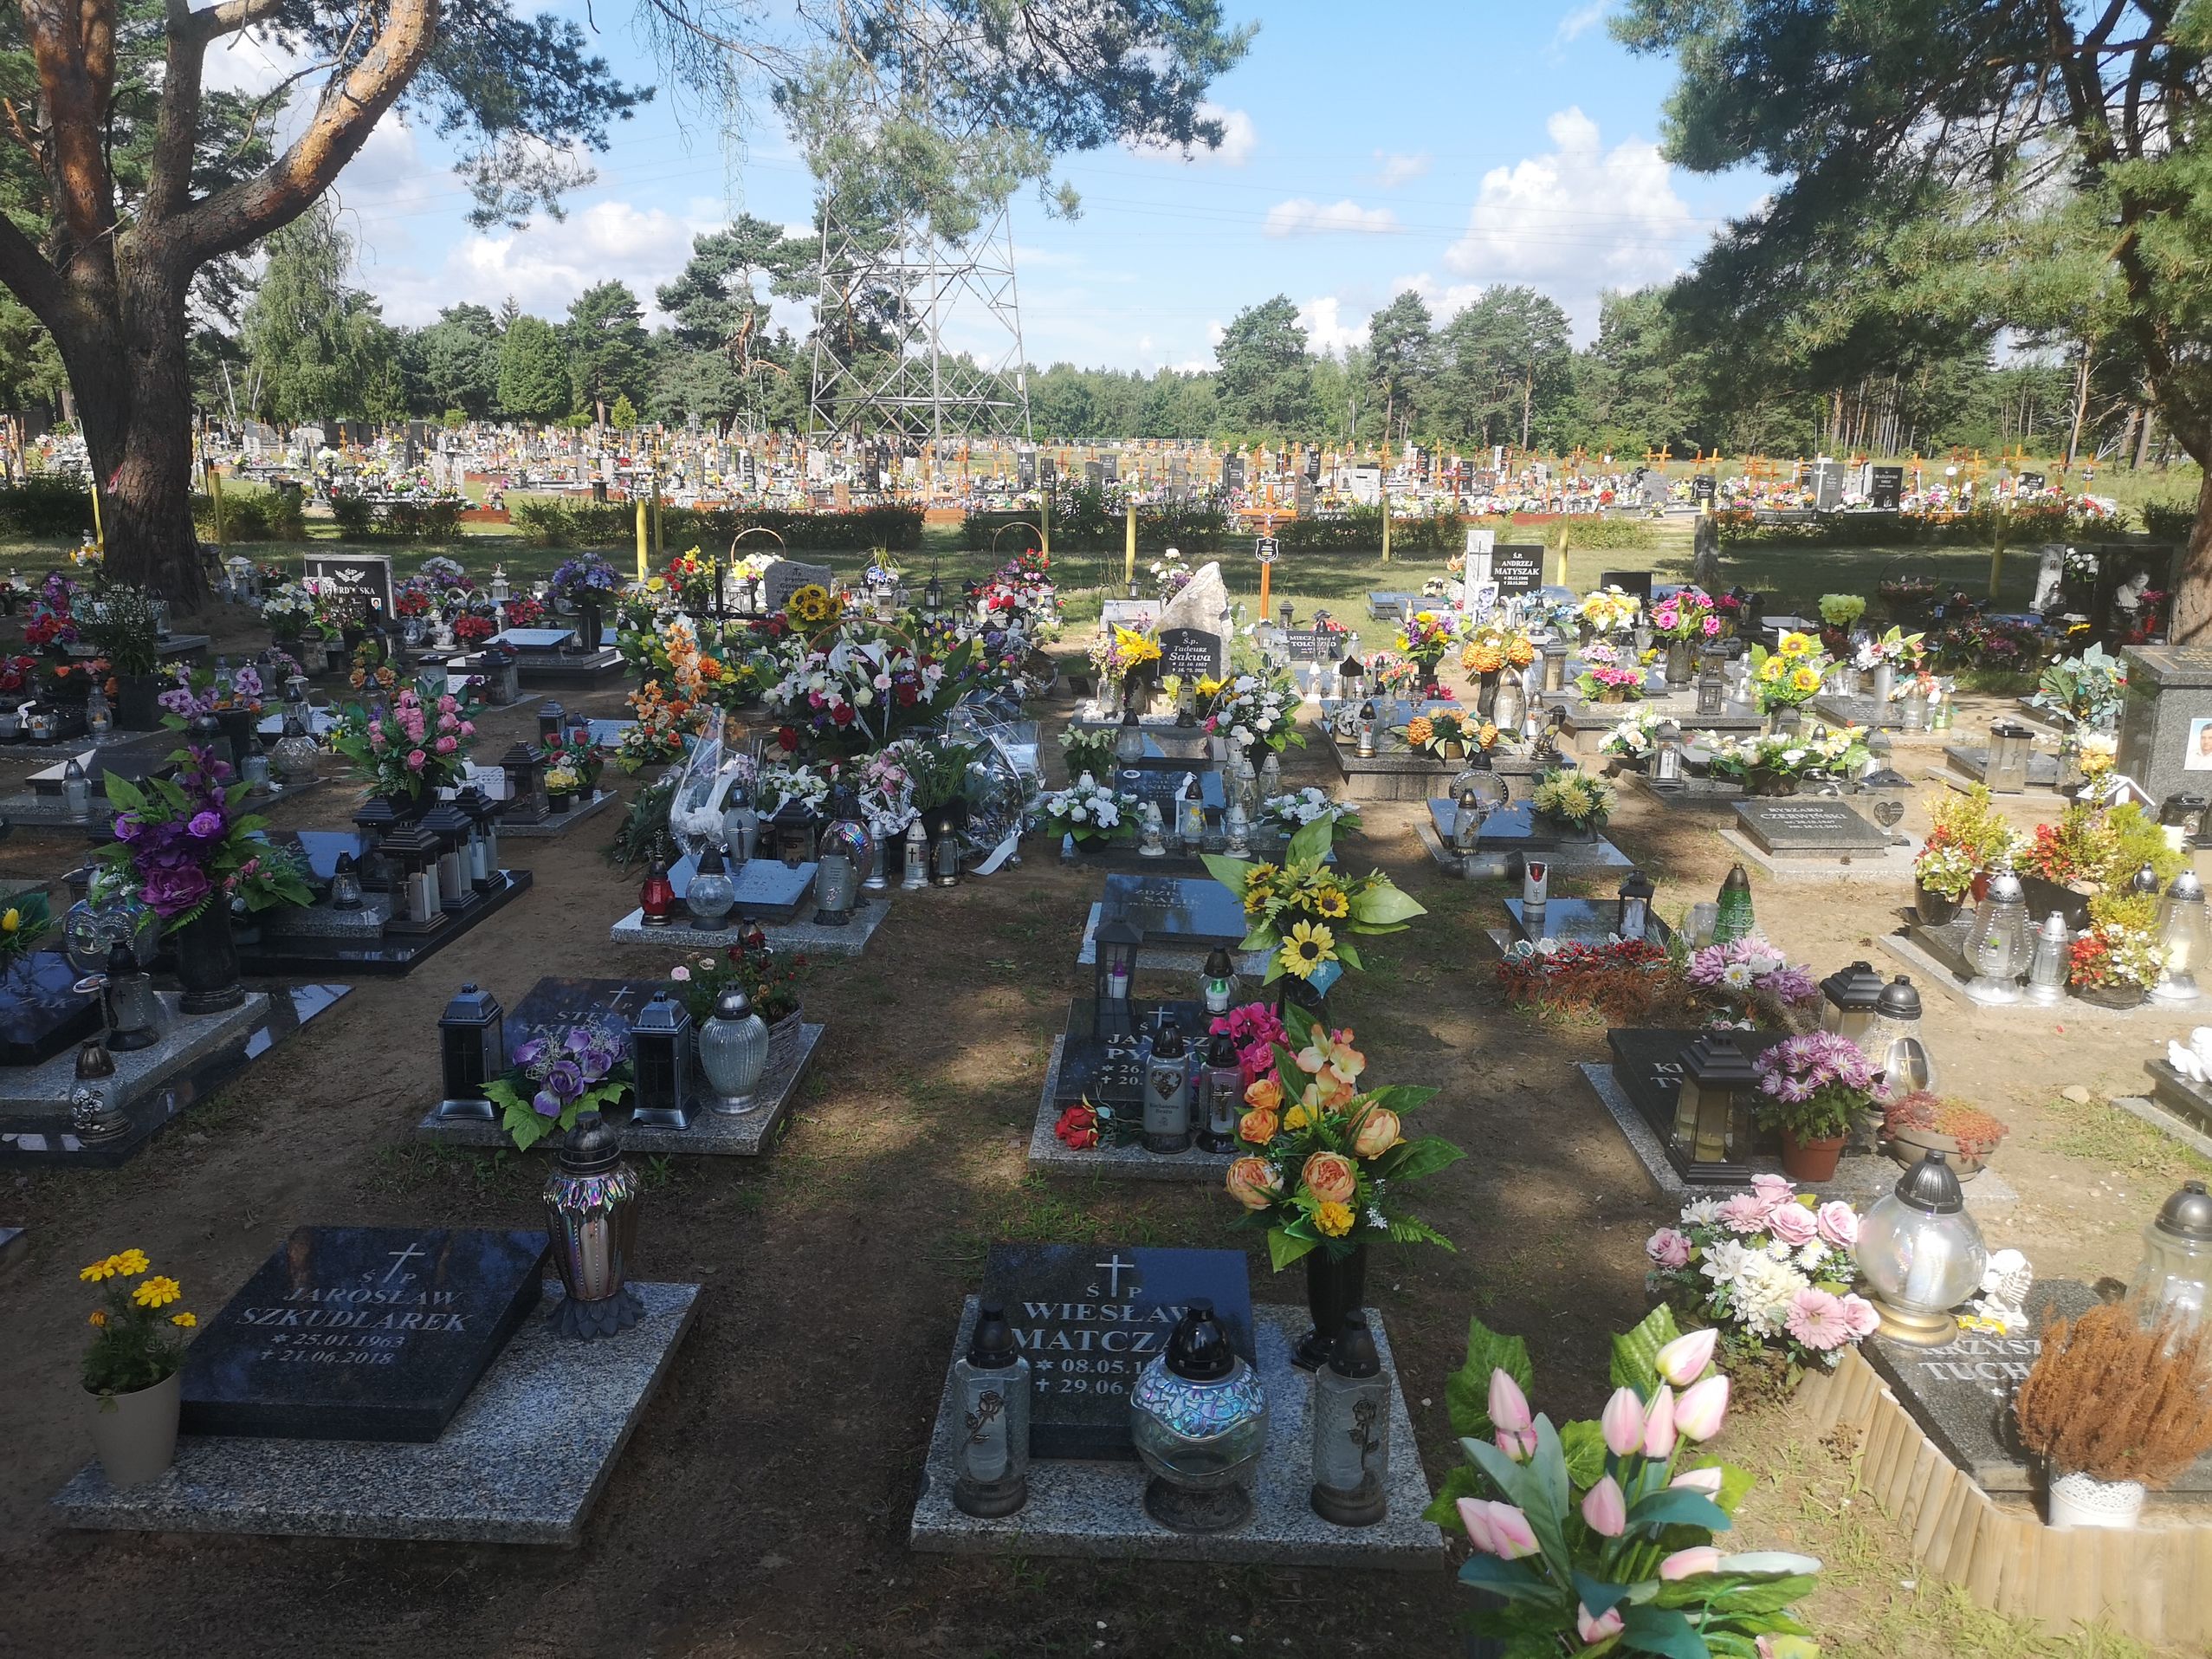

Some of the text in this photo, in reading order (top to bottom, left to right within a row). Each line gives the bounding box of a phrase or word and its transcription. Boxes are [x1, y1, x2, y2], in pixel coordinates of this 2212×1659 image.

[1169, 652, 1212, 662] Sakwa
[1107, 1034, 1210, 1047] JANSZ
[399, 1273, 417, 1284] P
[283, 1287, 463, 1306] JAROSŁAW
[1086, 1282, 1143, 1299] Ś P
[236, 1307, 474, 1332] SZKUDLAREK
[292, 1333, 406, 1348] 25.01.1963
[1010, 1327, 1173, 1354] MATCZ
[277, 1349, 395, 1365] 21.06.2018
